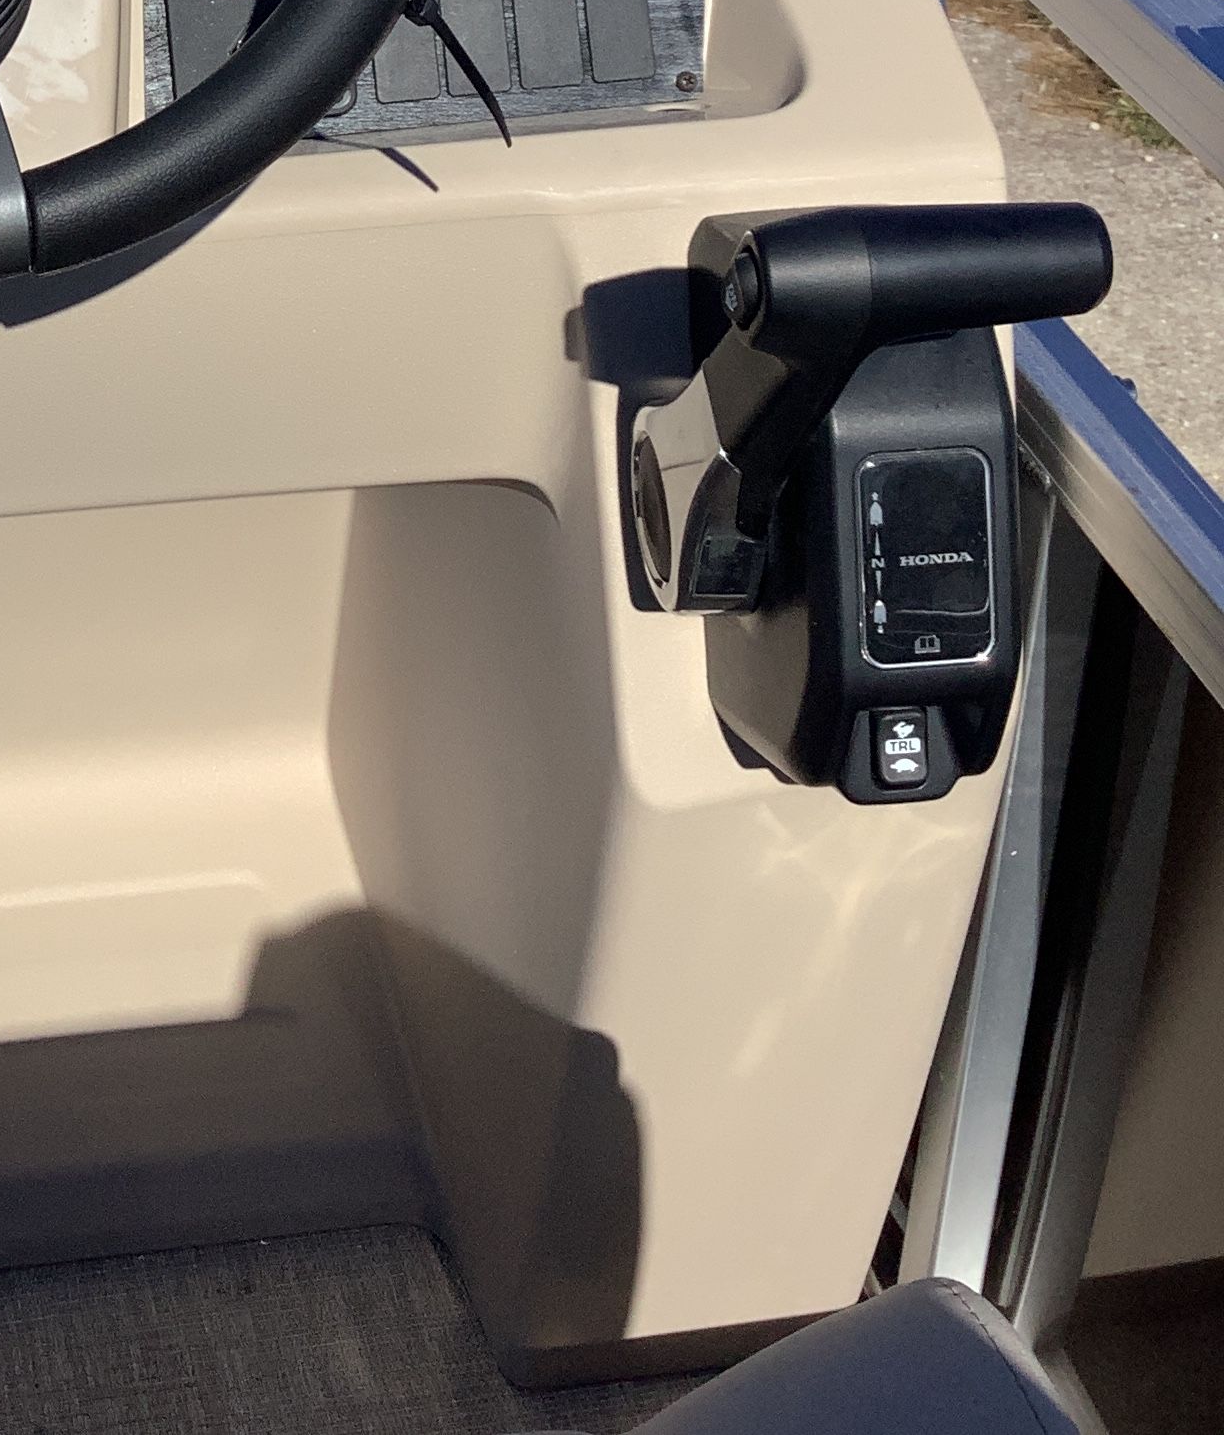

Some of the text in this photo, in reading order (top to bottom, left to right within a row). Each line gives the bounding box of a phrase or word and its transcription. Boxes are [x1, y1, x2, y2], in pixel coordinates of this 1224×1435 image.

[871, 557, 885, 568] N
[899, 551, 974, 566] HONDA
[889, 740, 917, 752] TRL
